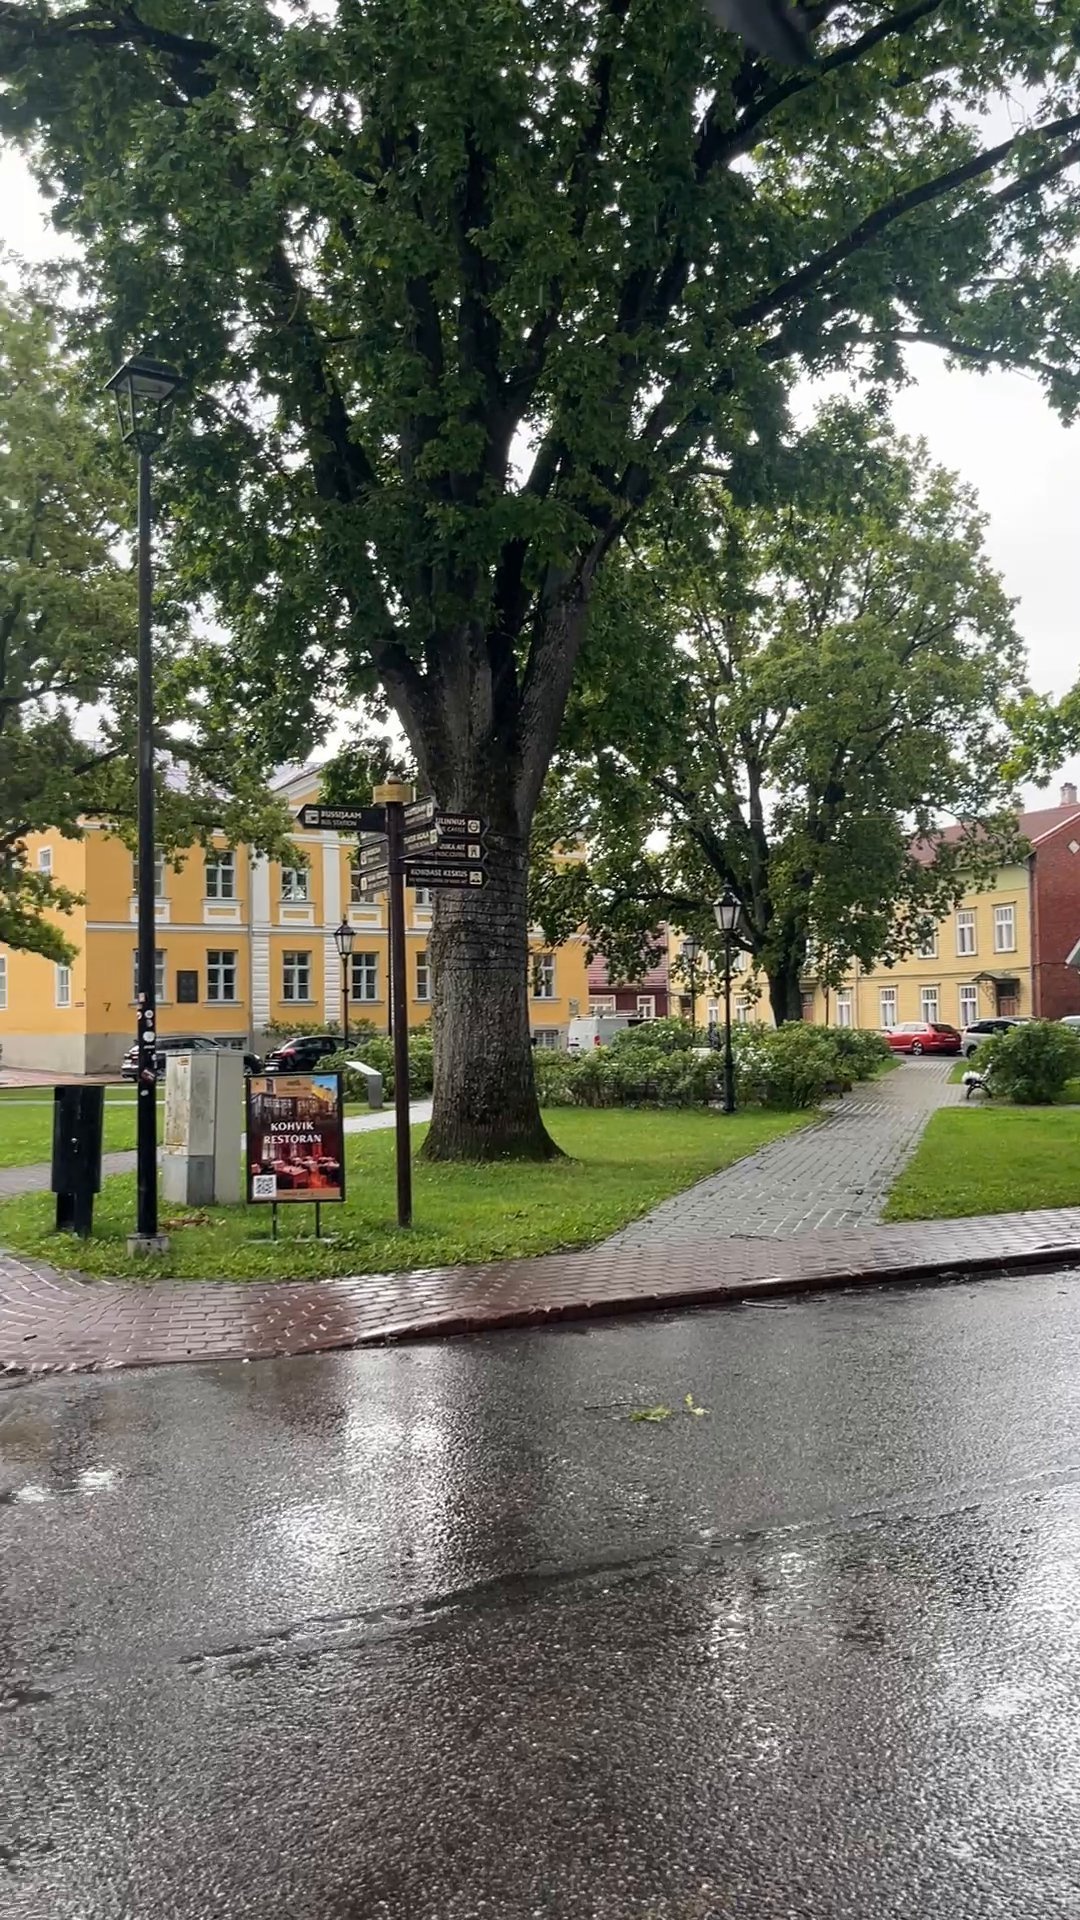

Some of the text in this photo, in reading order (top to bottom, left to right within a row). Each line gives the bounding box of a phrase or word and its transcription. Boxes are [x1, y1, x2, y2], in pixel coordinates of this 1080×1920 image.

[320, 810, 362, 820] BUSSIJAAM
[270, 1121, 315, 1132] KOHVIK
[263, 1134, 322, 1144] RESTORAN
